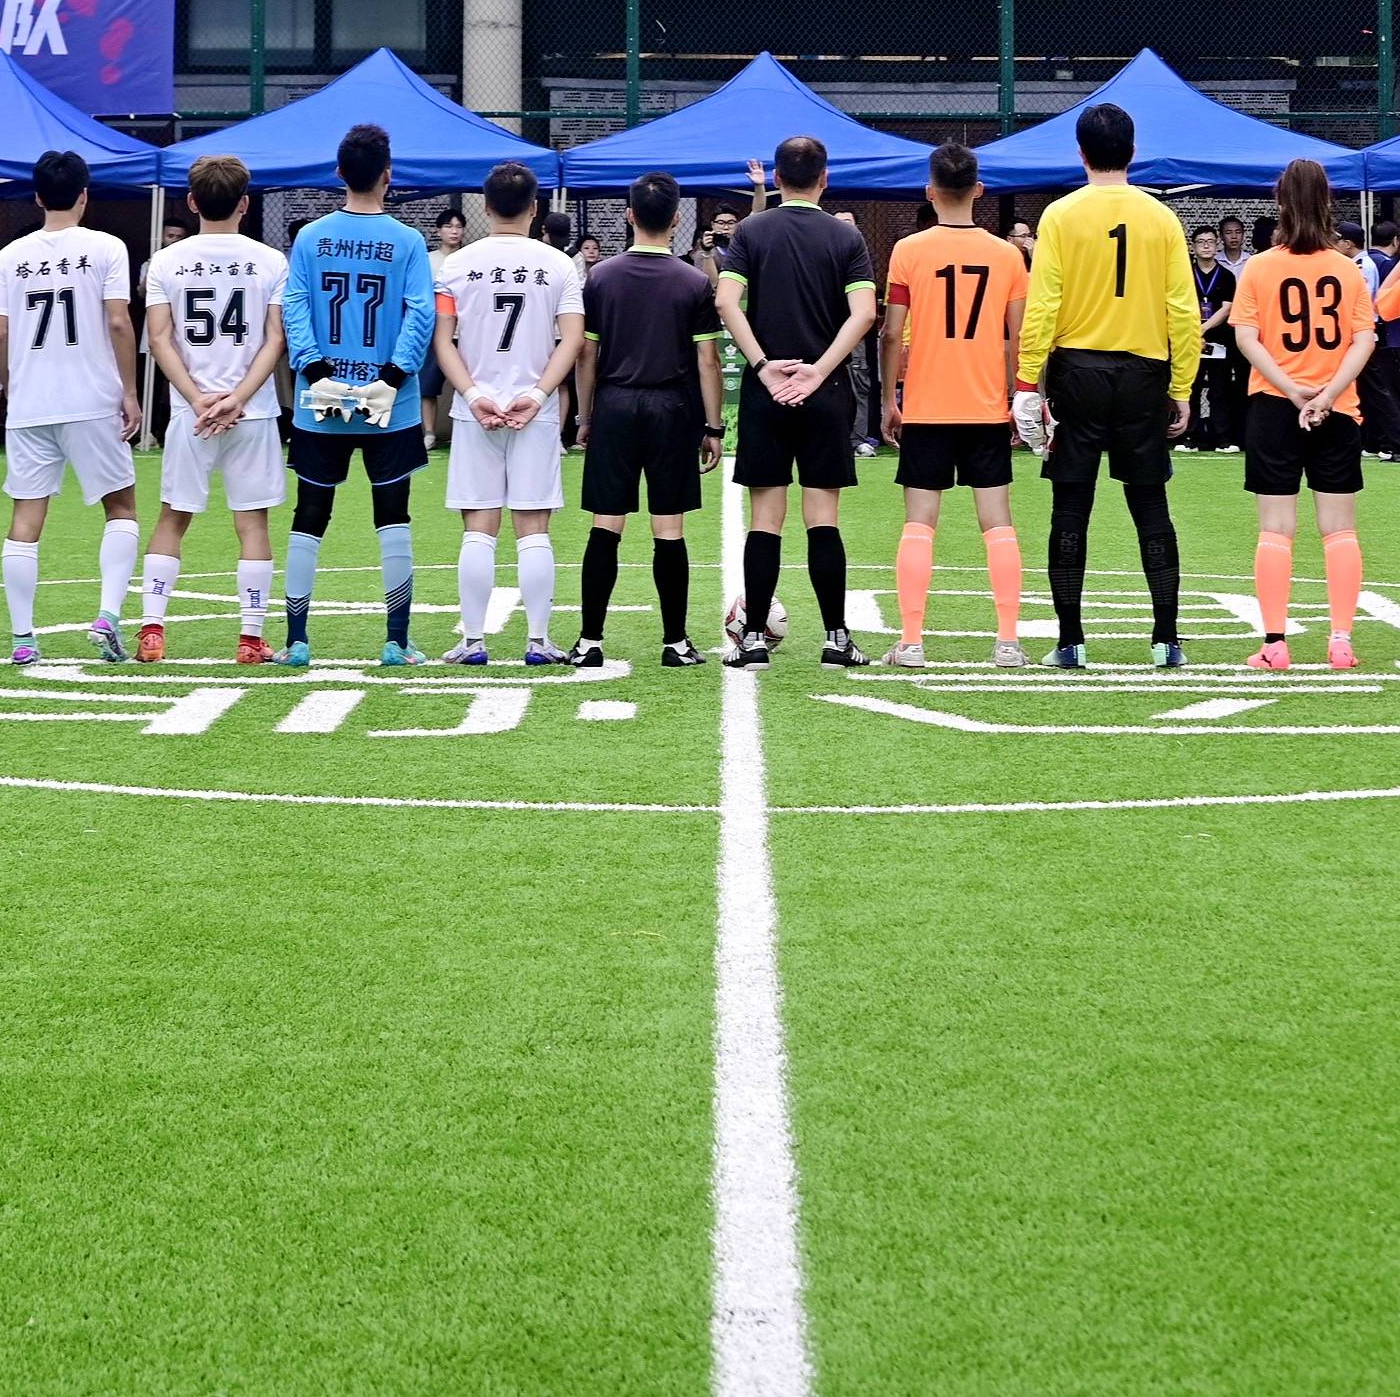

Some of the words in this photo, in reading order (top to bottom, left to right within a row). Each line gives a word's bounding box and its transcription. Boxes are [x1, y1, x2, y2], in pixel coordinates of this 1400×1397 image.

[16, 255, 91, 279] 塔石香羊
[175, 262, 258, 276] 小丹江苗寨
[316, 237, 394, 262] 贵州村超
[467, 266, 549, 286] 加宜苗寨
[1108, 223, 1127, 298] 1
[25, 286, 78, 349] 71
[184, 288, 249, 346] 54
[321, 271, 386, 347] 77
[493, 293, 526, 352] 7
[935, 264, 989, 340] 17
[1279, 275, 1342, 353] 93
